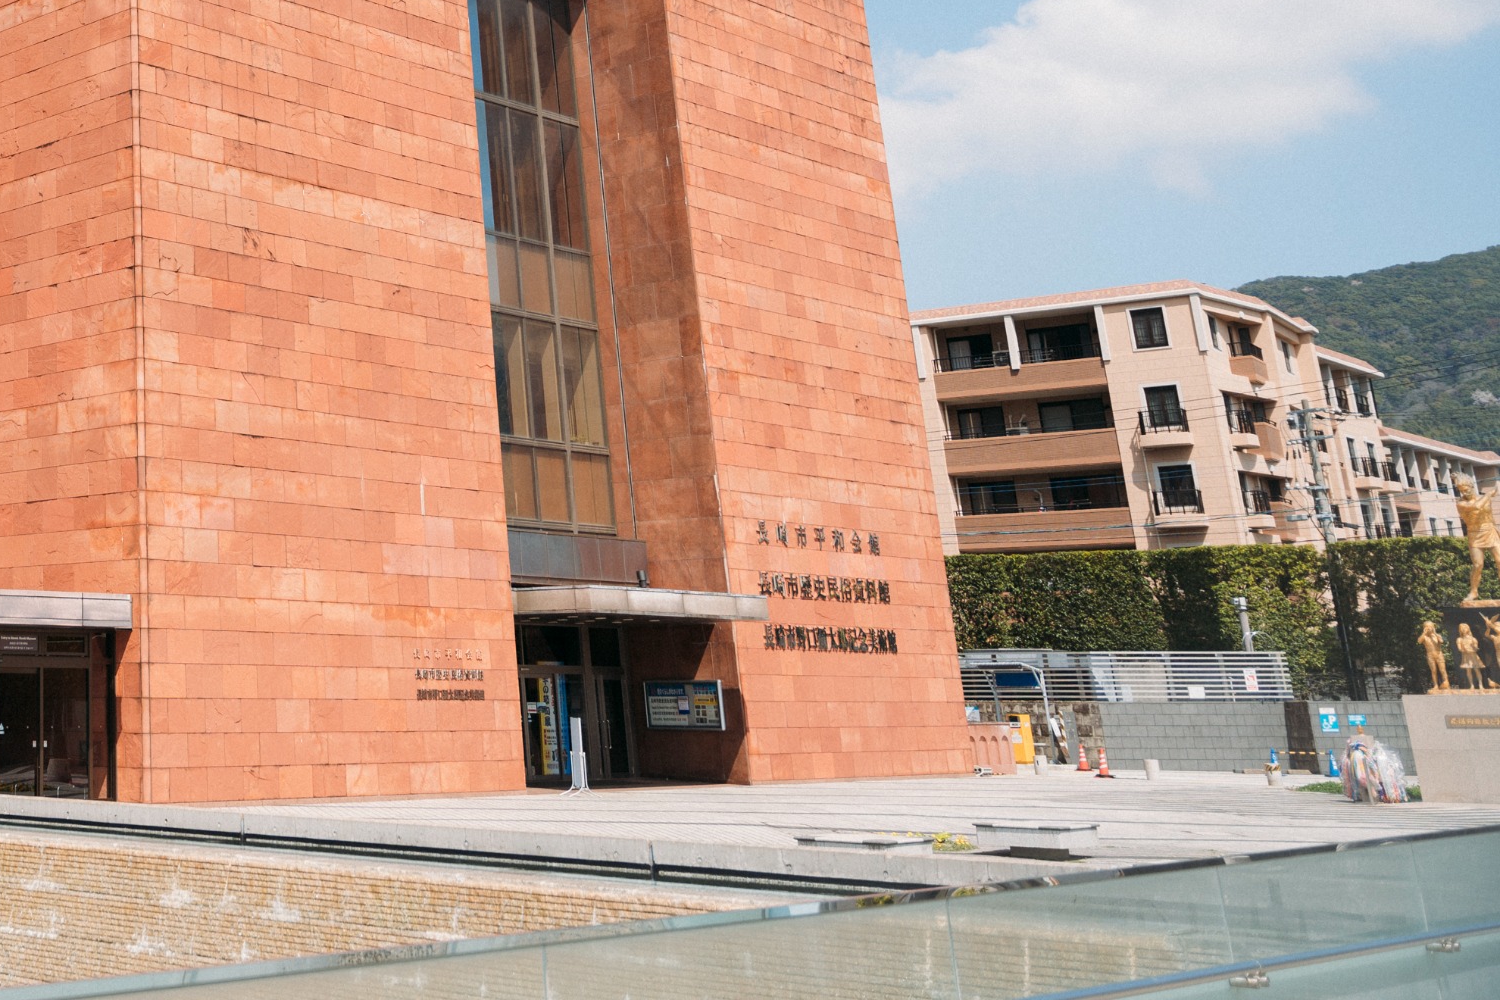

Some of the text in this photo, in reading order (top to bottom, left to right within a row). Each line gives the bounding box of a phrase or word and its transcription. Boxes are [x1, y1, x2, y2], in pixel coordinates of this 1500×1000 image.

[756, 520, 881, 556] 長崎市平和会館
[1328, 715, 1336, 725] P
